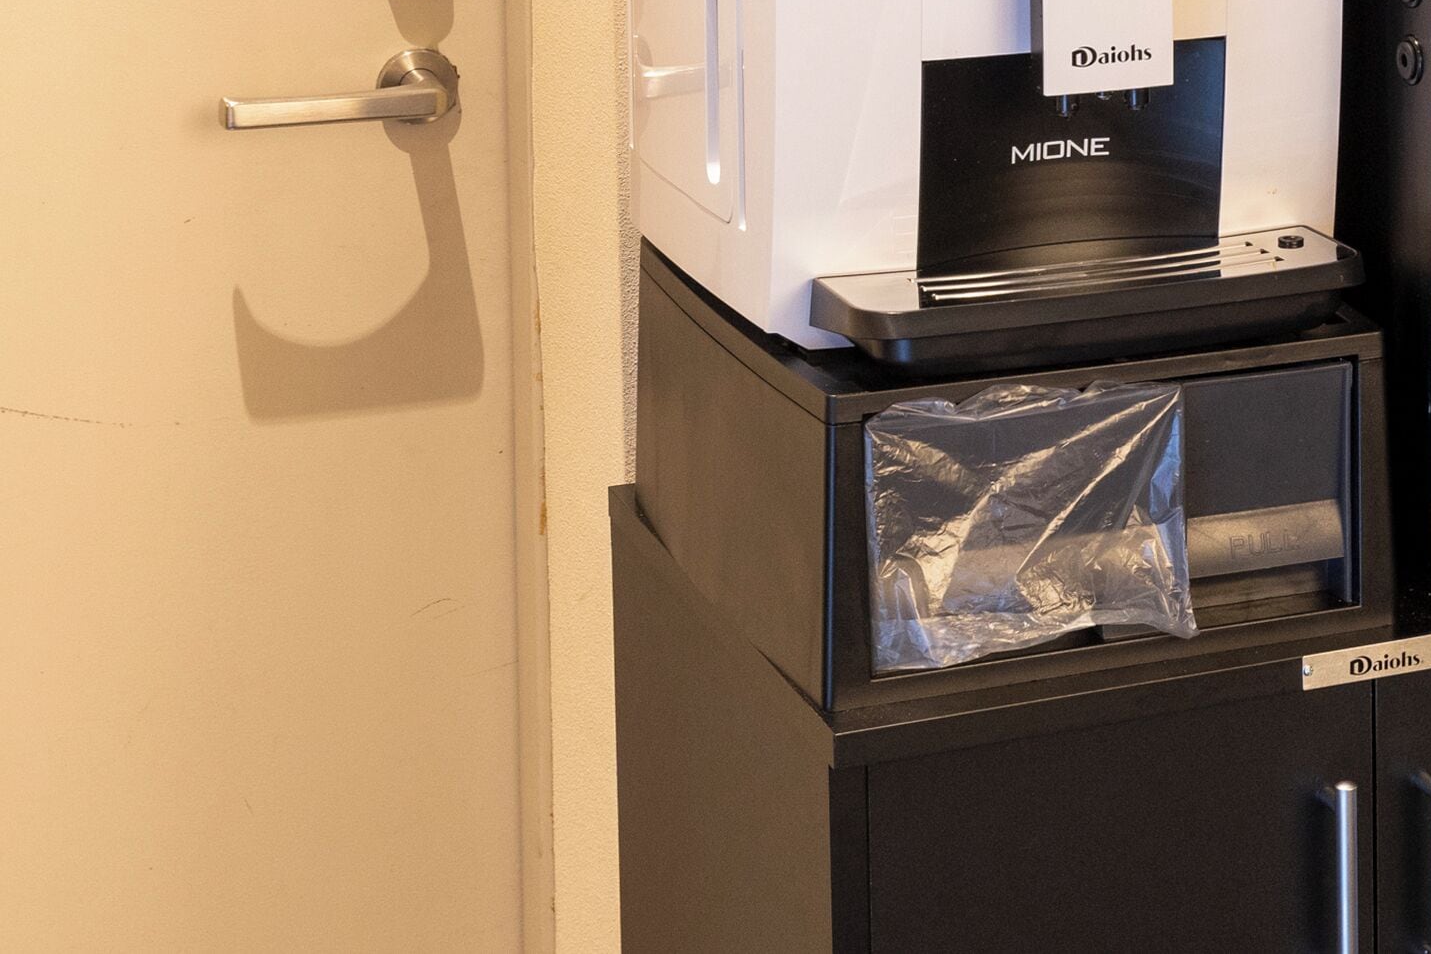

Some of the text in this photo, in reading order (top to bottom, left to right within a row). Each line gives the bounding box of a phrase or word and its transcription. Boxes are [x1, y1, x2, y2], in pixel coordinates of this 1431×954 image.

[1072, 44, 1152, 68] Daiohs
[1011, 136, 1110, 164] MIONE
[1229, 532, 1298, 560] PULL
